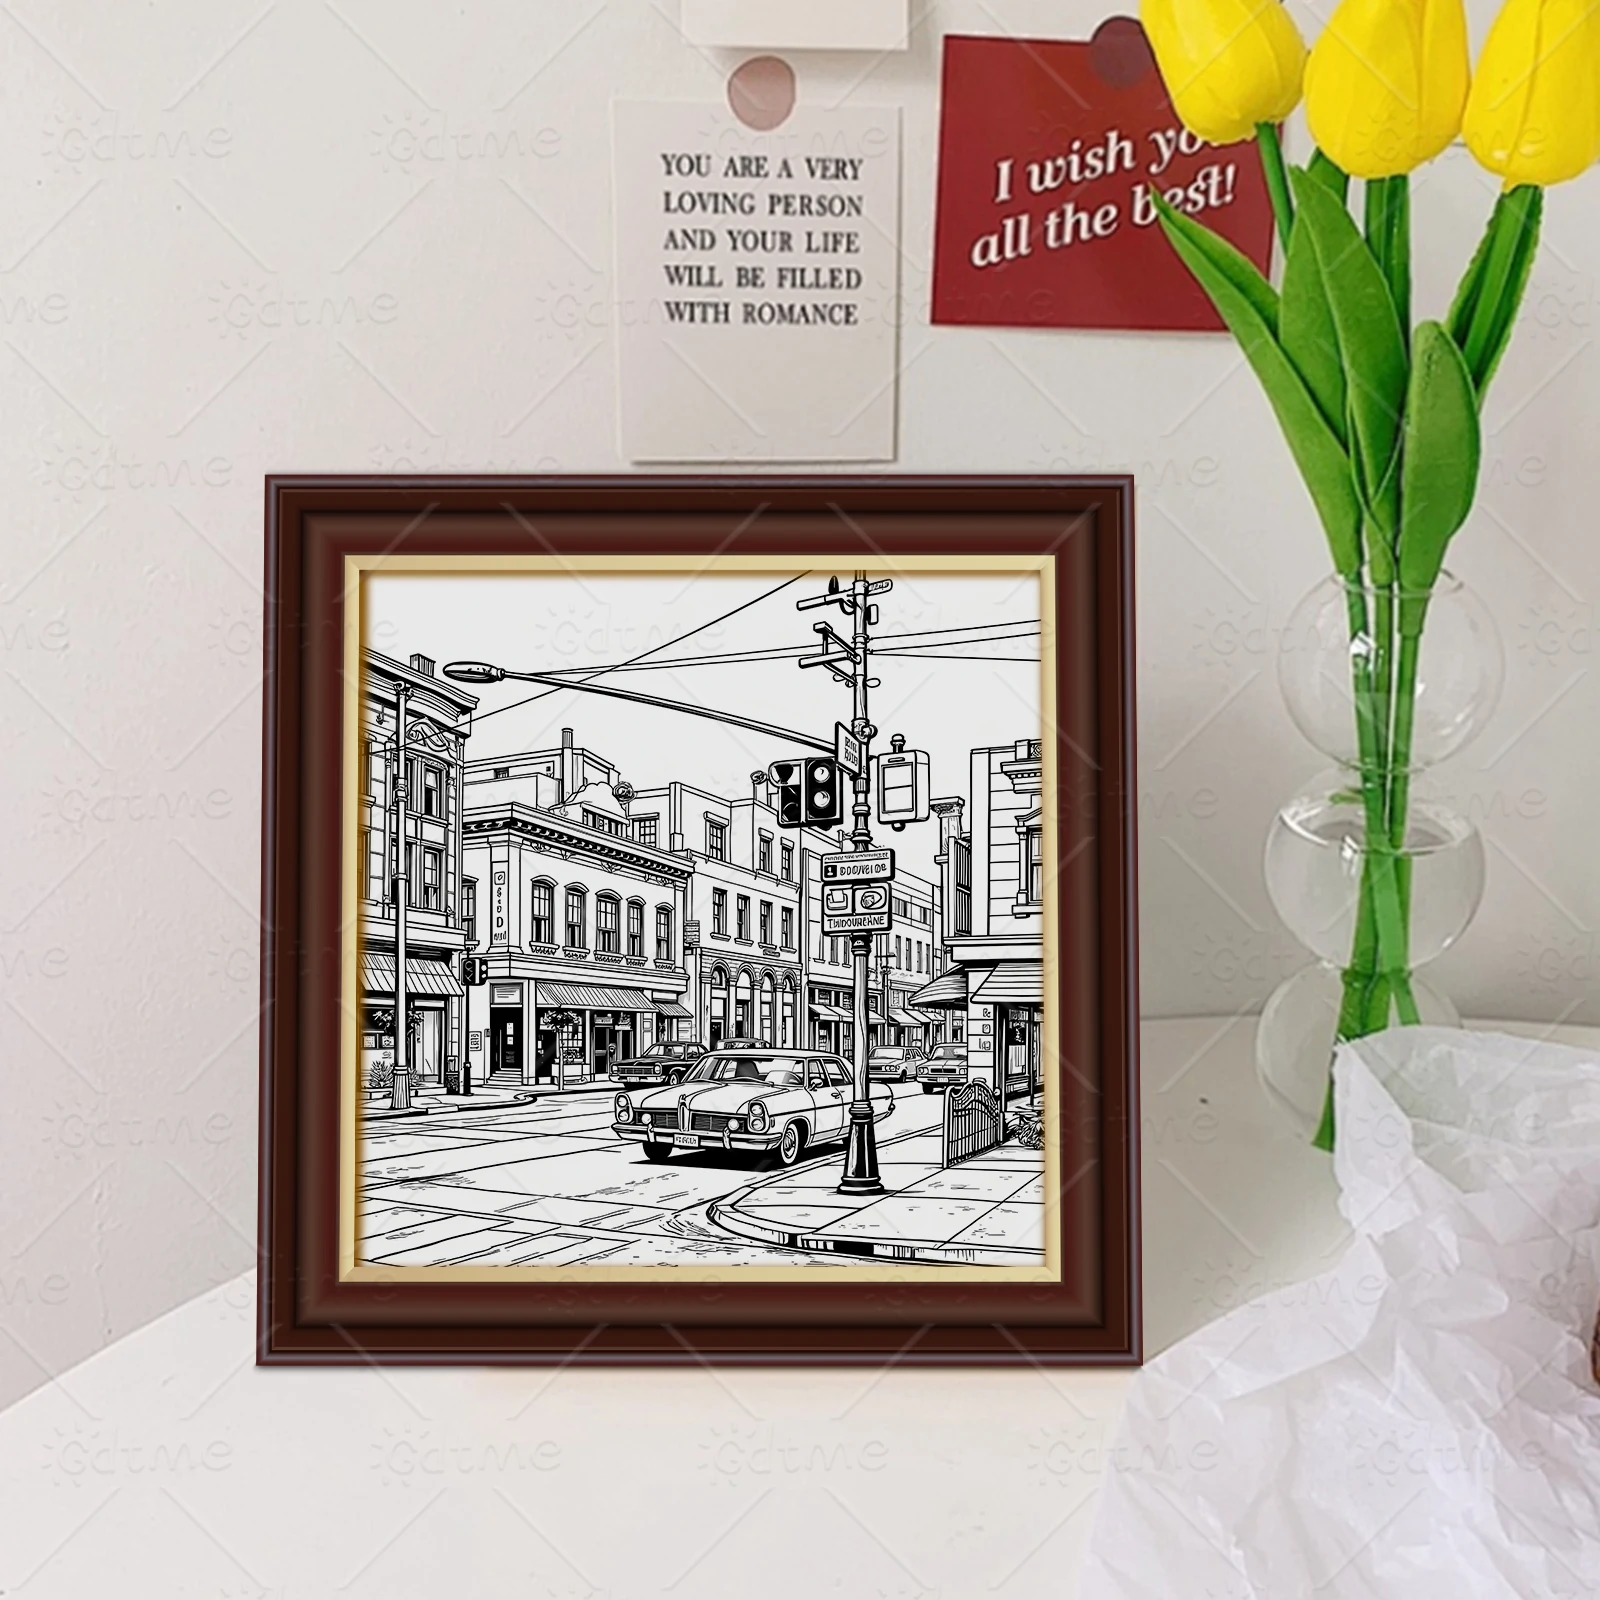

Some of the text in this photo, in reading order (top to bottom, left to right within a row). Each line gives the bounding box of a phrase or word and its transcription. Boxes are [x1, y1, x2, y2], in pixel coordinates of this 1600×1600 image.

[661, 153, 863, 181] YOU ARE A VERY
[994, 127, 1207, 203] I wish yo
[663, 191, 863, 217] LOVING PERSON
[970, 162, 1237, 268] all the best!
[664, 228, 860, 254] AND YOUR LIFE
[663, 264, 863, 290] WILL BE FILLED
[664, 300, 730, 324] WITH
[742, 302, 858, 326] ROMANCE
